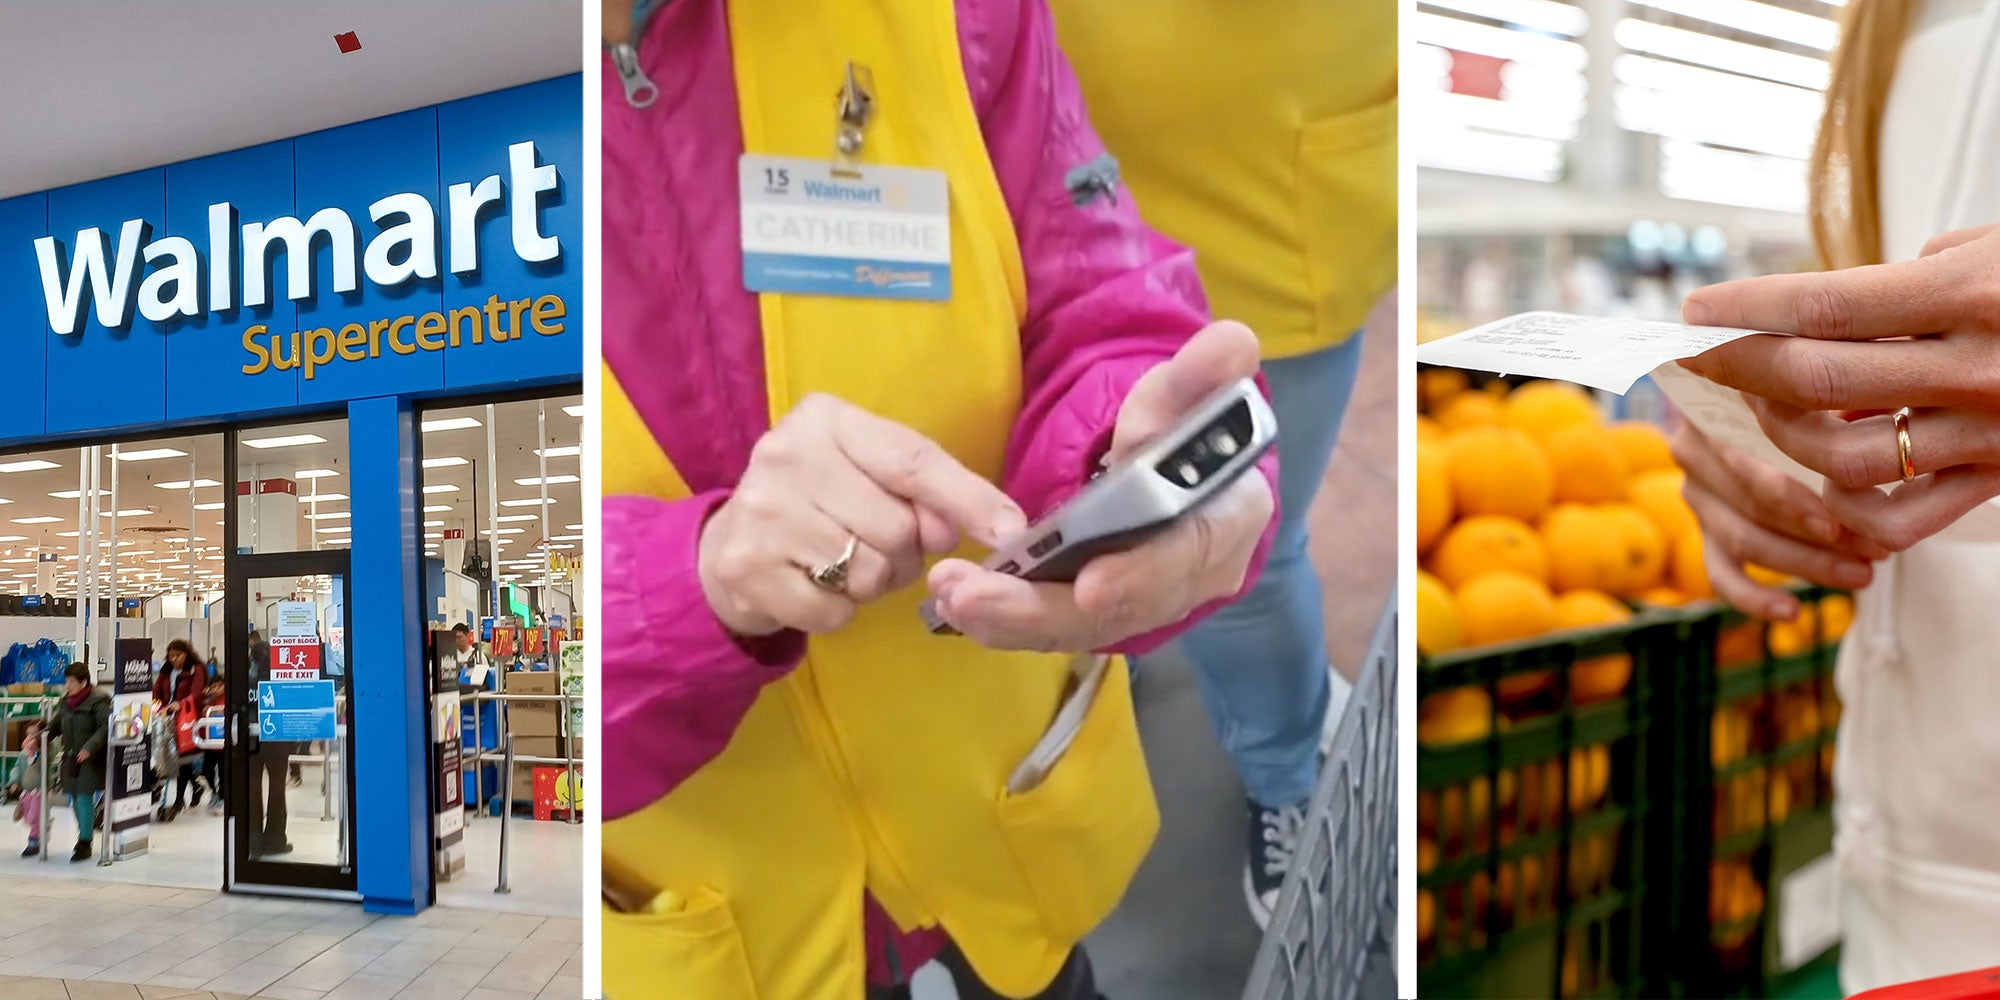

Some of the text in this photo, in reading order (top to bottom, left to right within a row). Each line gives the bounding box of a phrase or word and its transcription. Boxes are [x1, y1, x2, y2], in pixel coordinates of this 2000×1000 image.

[764, 168, 789, 187] 15
[803, 180, 882, 203] Walmart
[34, 140, 562, 338] Walmart
[755, 212, 941, 252] CATHERINE
[241, 293, 566, 380] Supercentre
[272, 637, 317, 645] DO NOT BLOCK
[276, 671, 314, 679] FIRE EXIT
